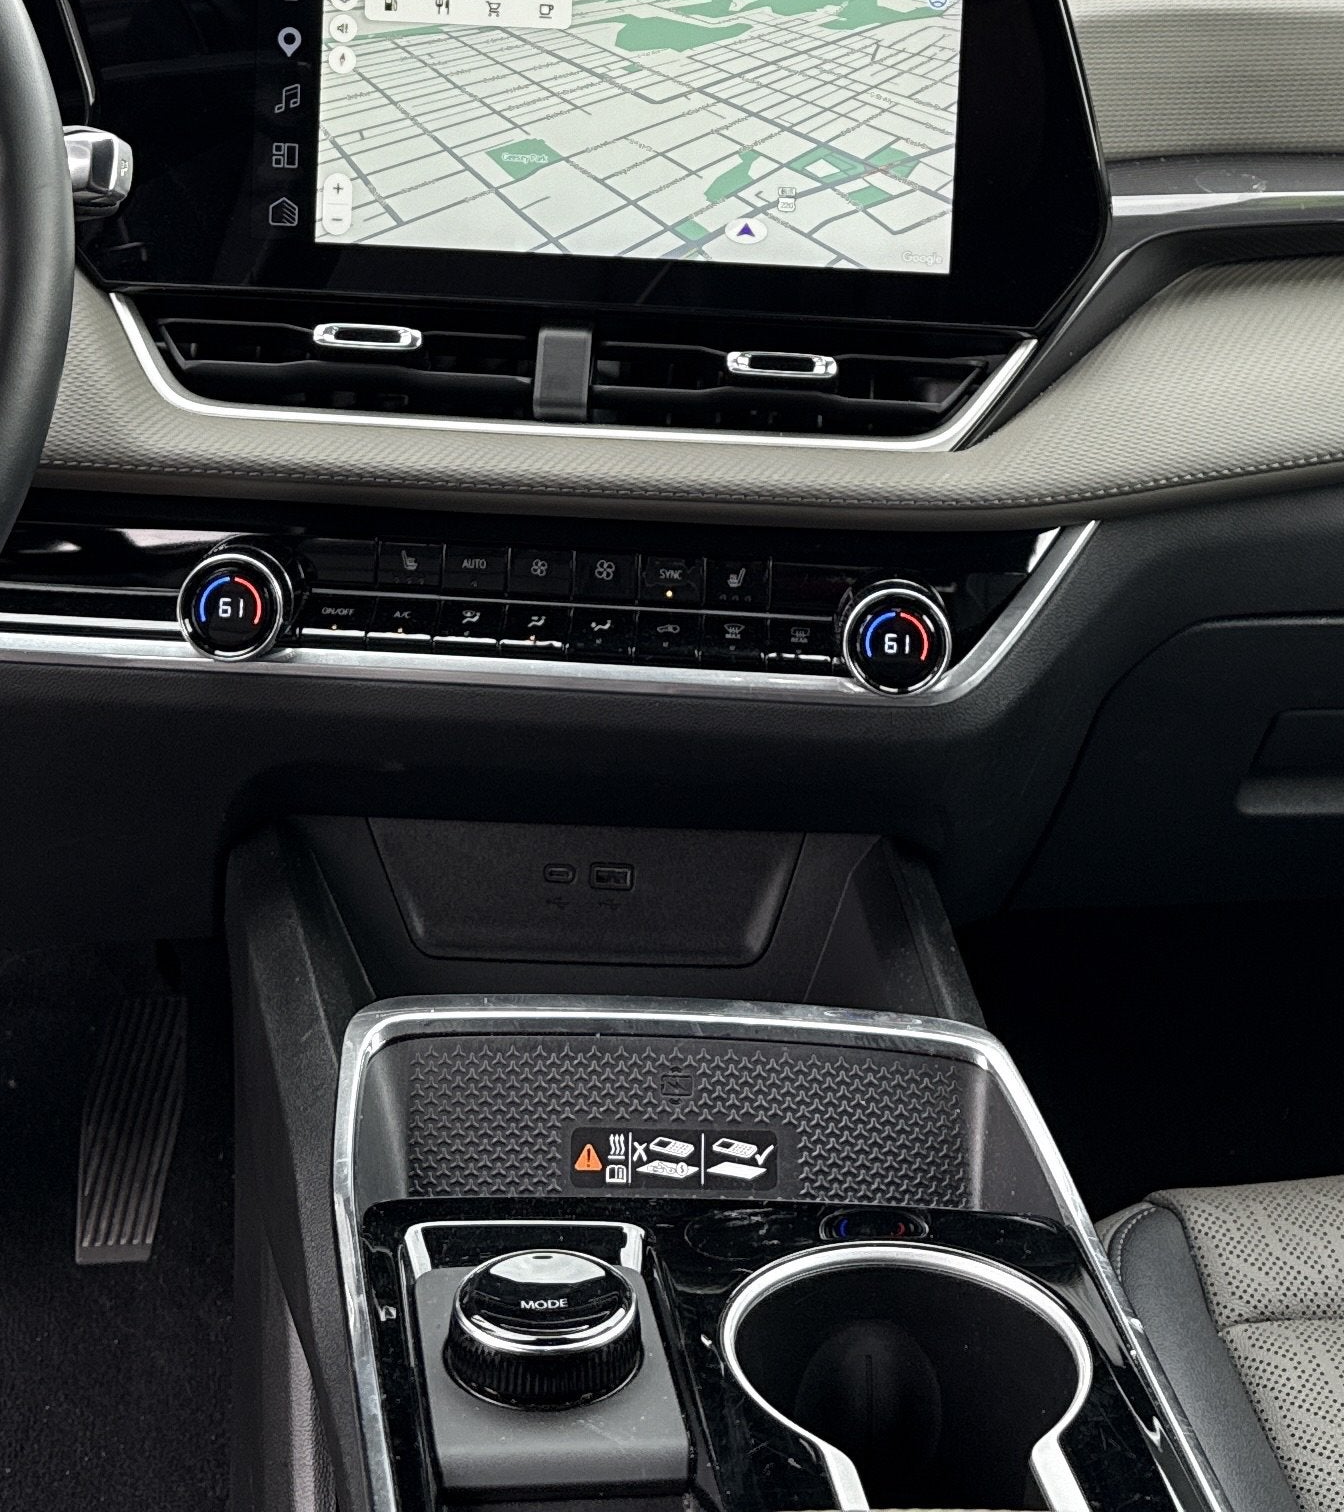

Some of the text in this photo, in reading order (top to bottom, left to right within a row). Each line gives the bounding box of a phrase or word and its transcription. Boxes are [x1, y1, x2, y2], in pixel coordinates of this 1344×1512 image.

[530, 153, 549, 164] Park
[902, 251, 944, 266] Google
[461, 558, 487, 570] AUTO
[659, 569, 684, 582] SYNC
[219, 597, 244, 619] 61
[321, 606, 355, 617] ON/OFF
[393, 610, 412, 619] A/C
[884, 634, 911, 655] 61
[520, 1298, 569, 1310] MODE
